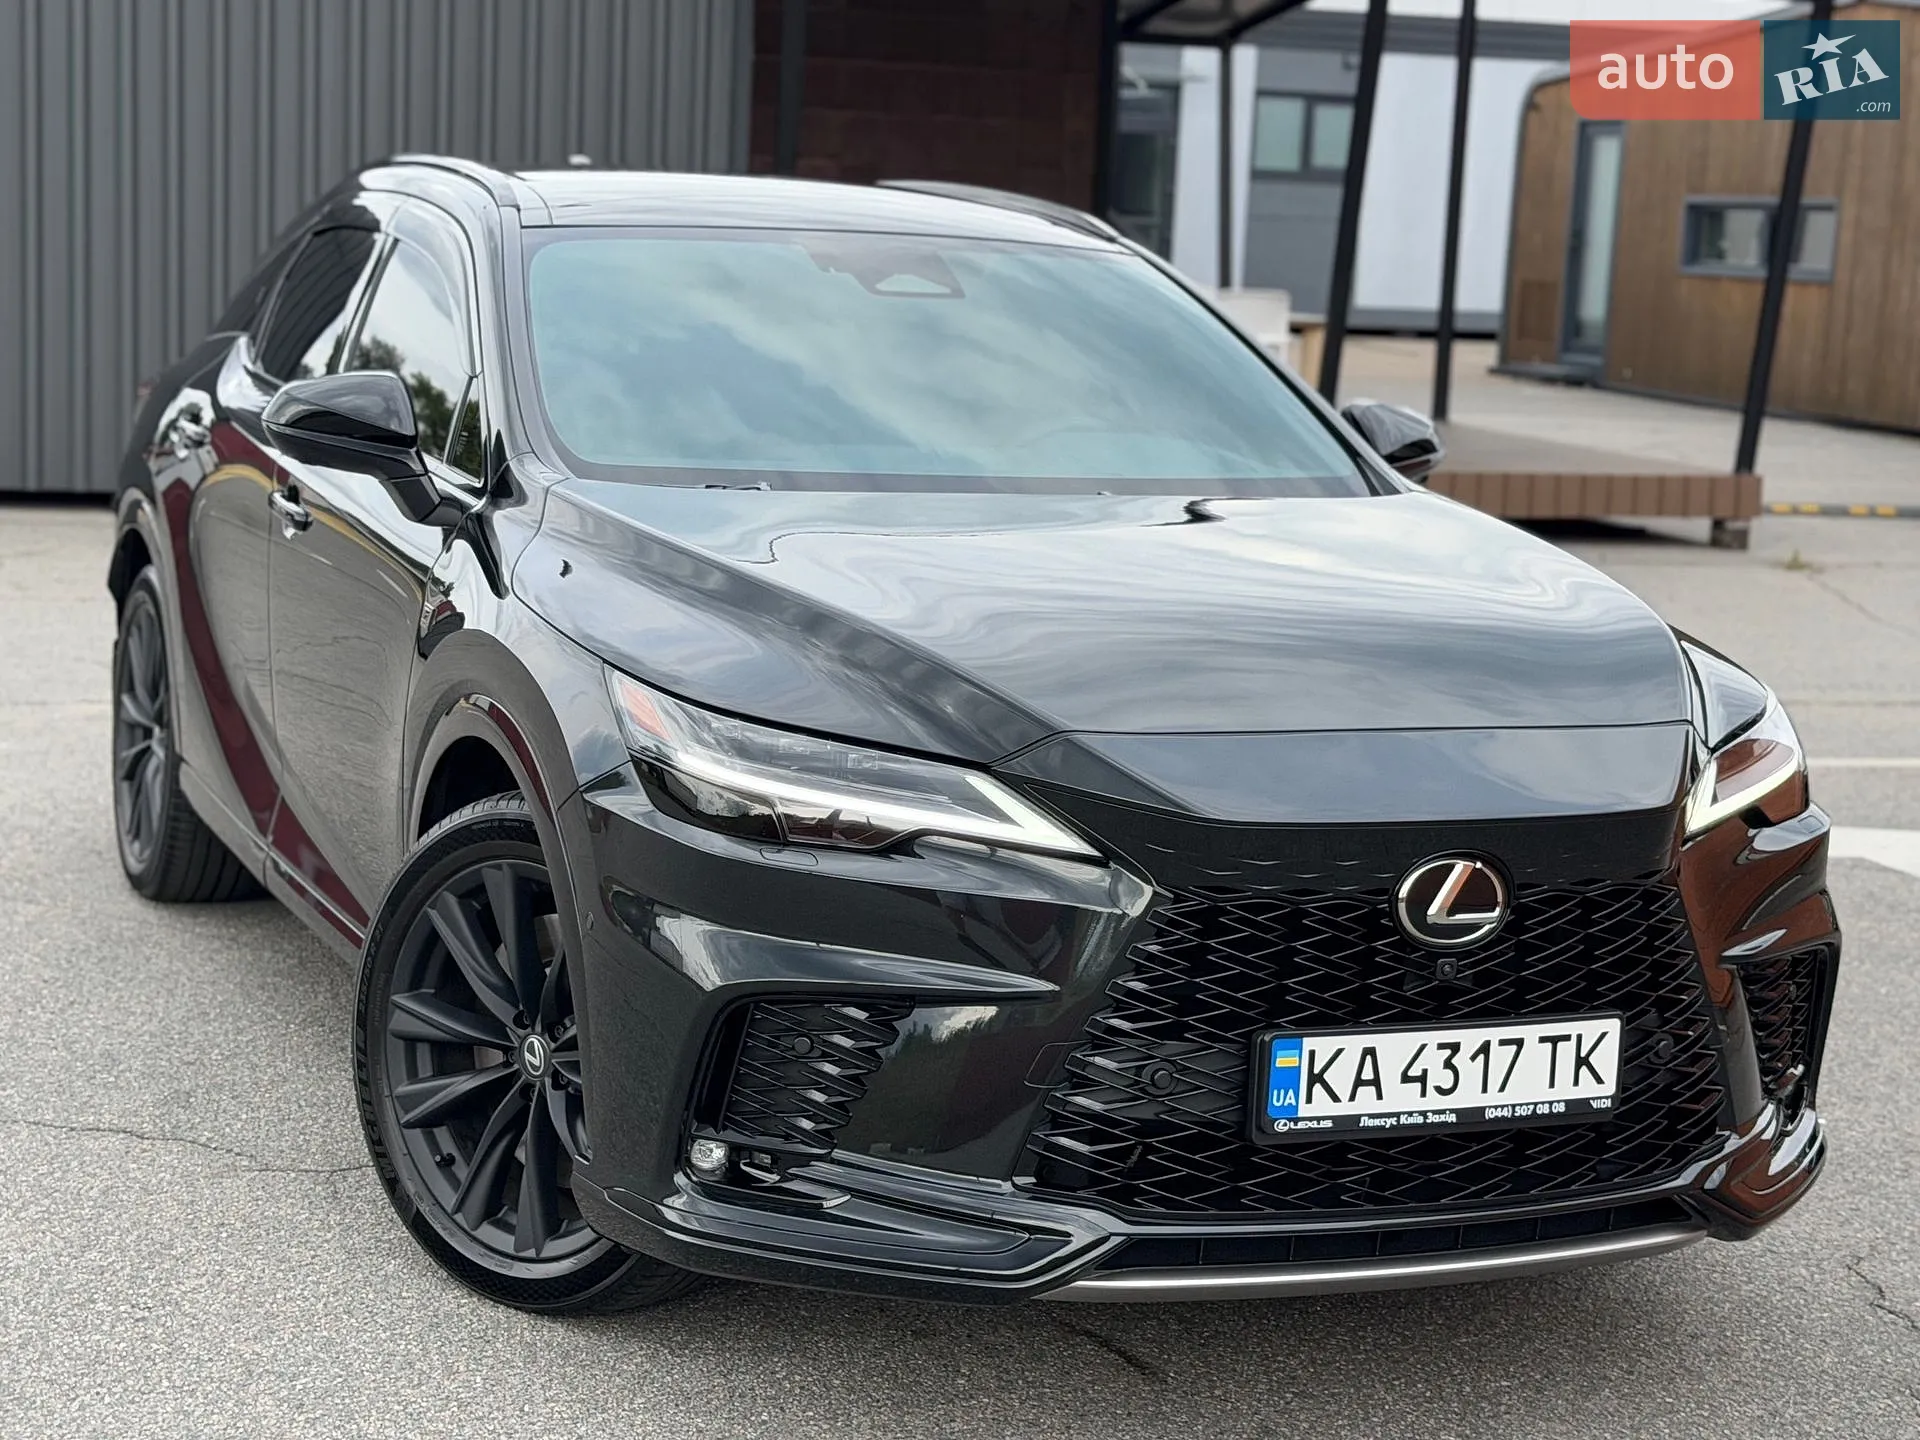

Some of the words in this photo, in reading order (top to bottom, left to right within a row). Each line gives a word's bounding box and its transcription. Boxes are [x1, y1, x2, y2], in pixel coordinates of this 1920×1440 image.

[1304, 1046, 1384, 1105] KA
[1400, 1037, 1525, 1099] 4317
[1538, 1031, 1610, 1089] TK
[1272, 1089, 1297, 1107] UA
[1485, 1106, 1512, 1120] (044)
[1514, 1104, 1534, 1116] 507
[1535, 1103, 1550, 1114] 08
[1289, 1119, 1333, 1129] LEXUS
